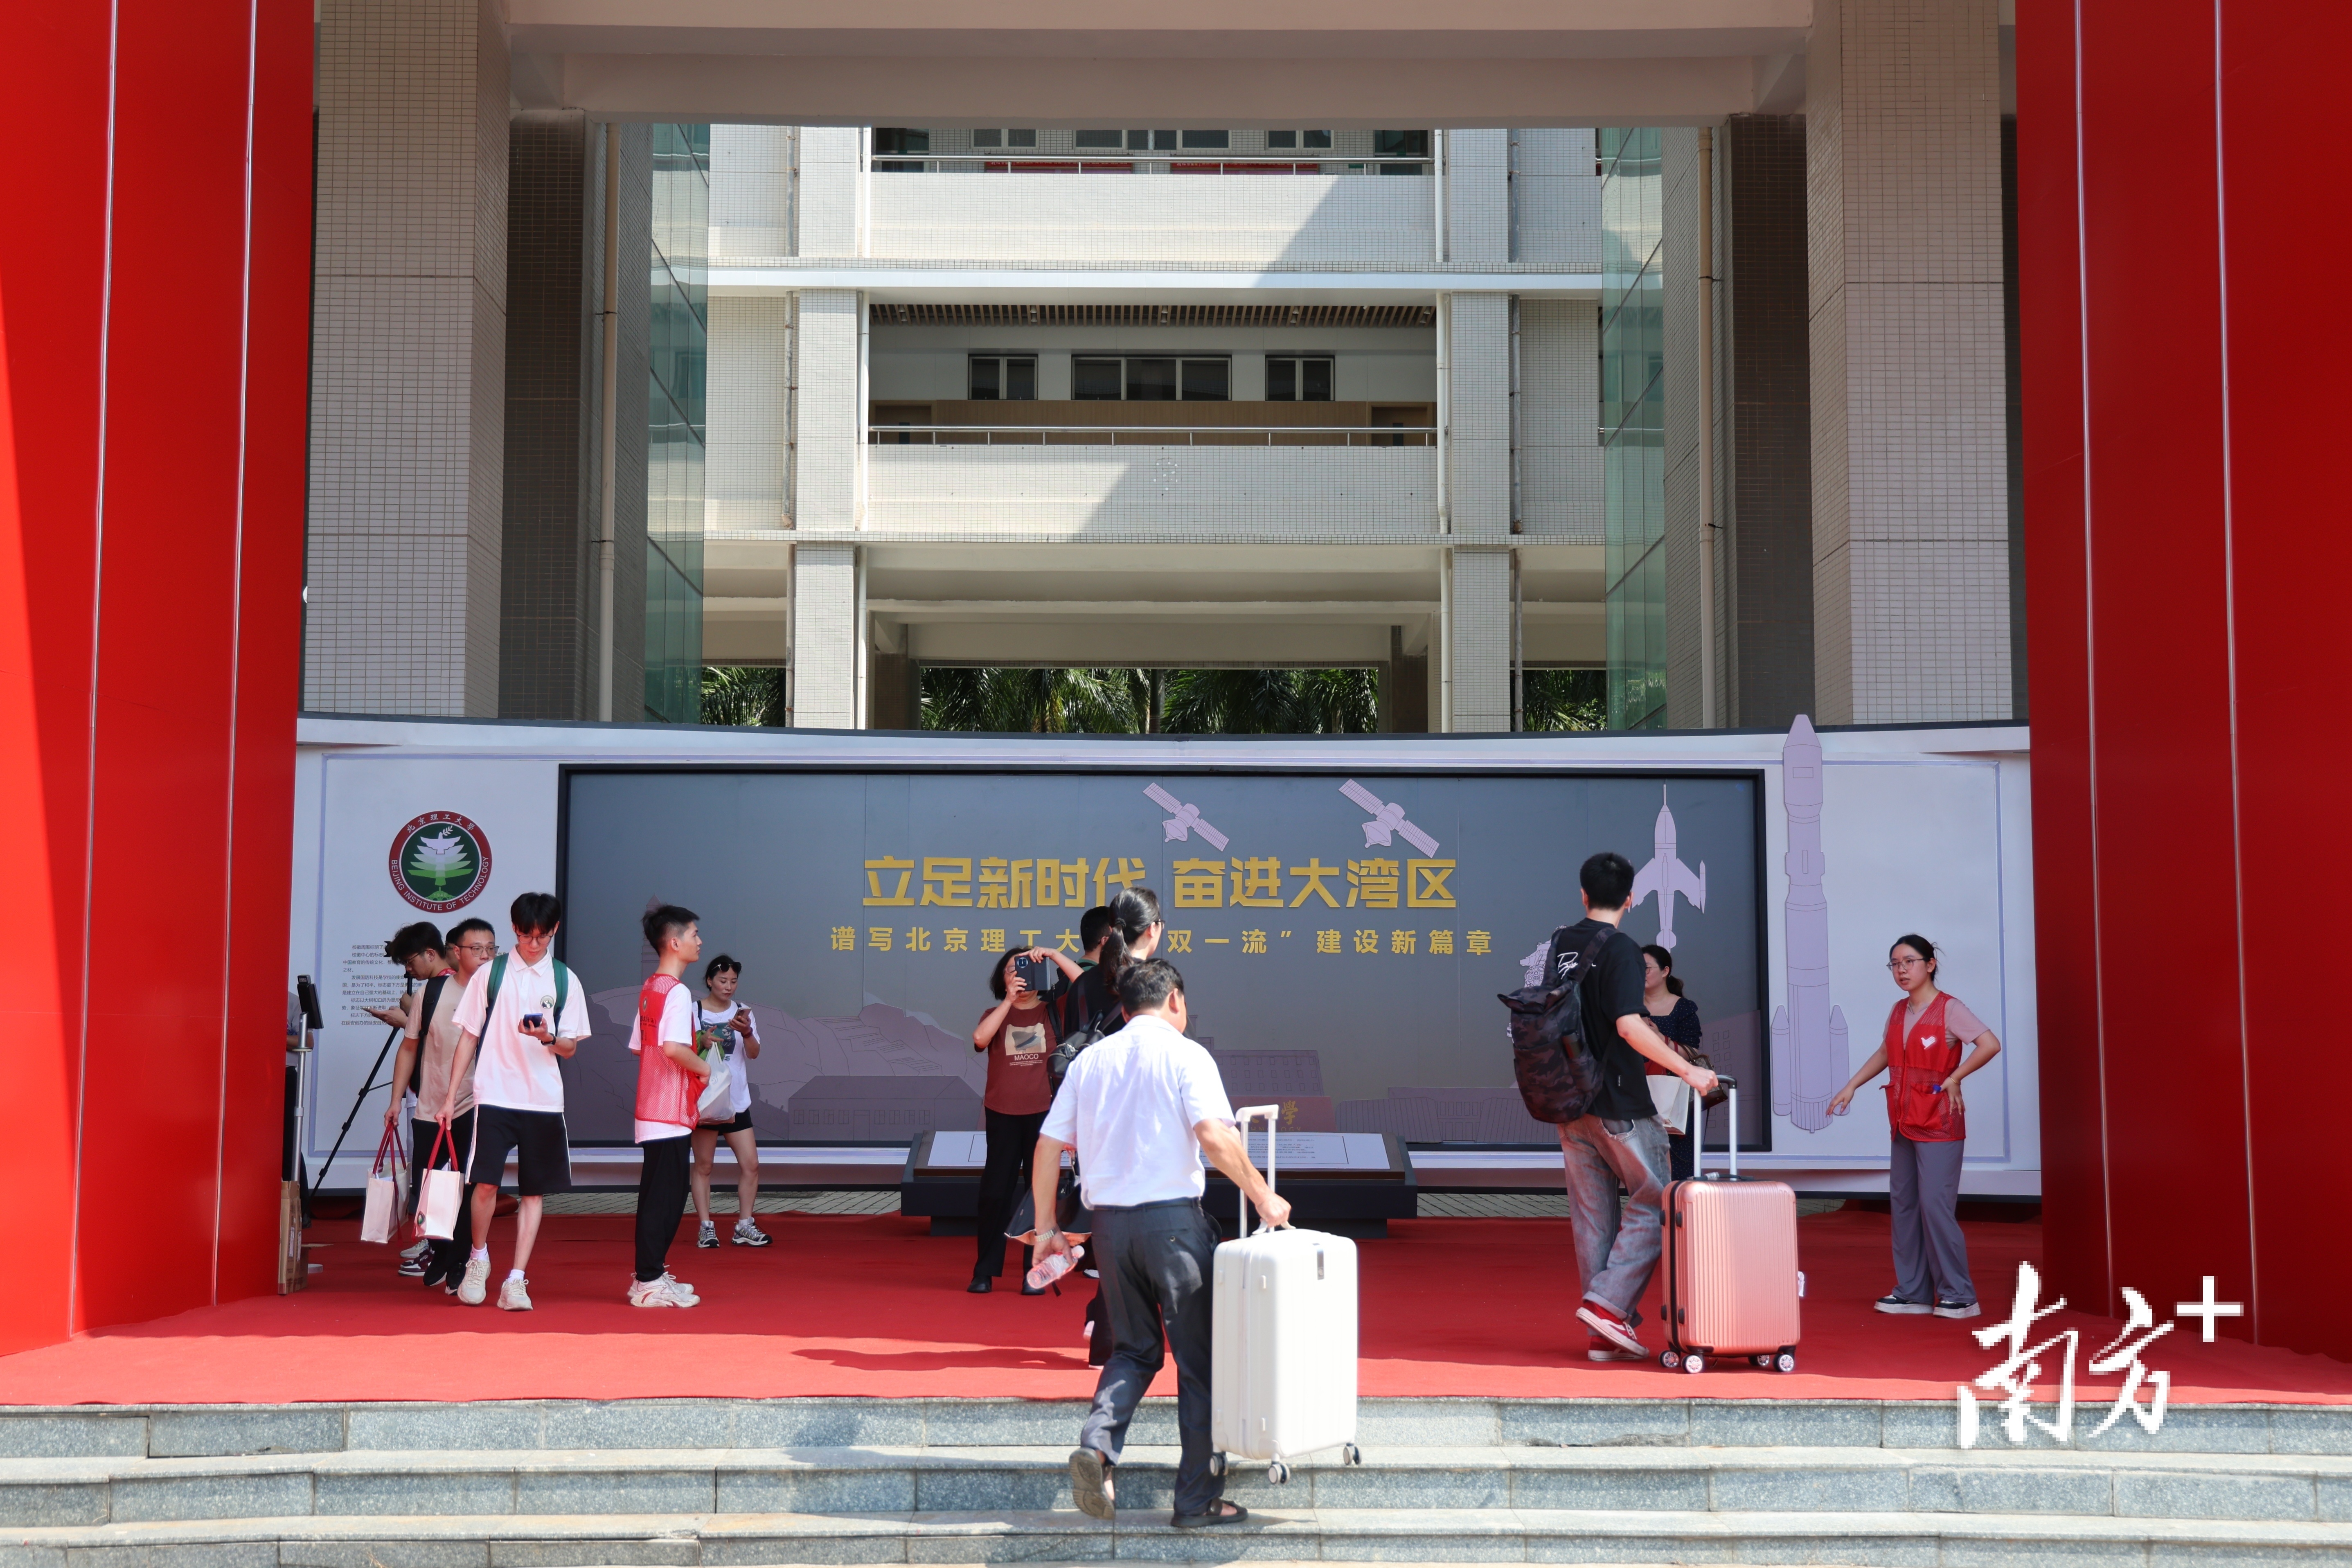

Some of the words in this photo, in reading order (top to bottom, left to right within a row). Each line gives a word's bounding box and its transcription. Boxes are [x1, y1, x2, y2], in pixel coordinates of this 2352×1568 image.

[407, 813, 475, 833] 北京理工大學
[392, 860, 405, 890] BEIJING
[403, 890, 442, 911] INSTITUTE
[446, 901, 457, 910] OF
[459, 856, 489, 904] TECHNOLOGY
[863, 856, 1145, 908] 立足新时代
[1172, 856, 1457, 908] 奋进大湾区
